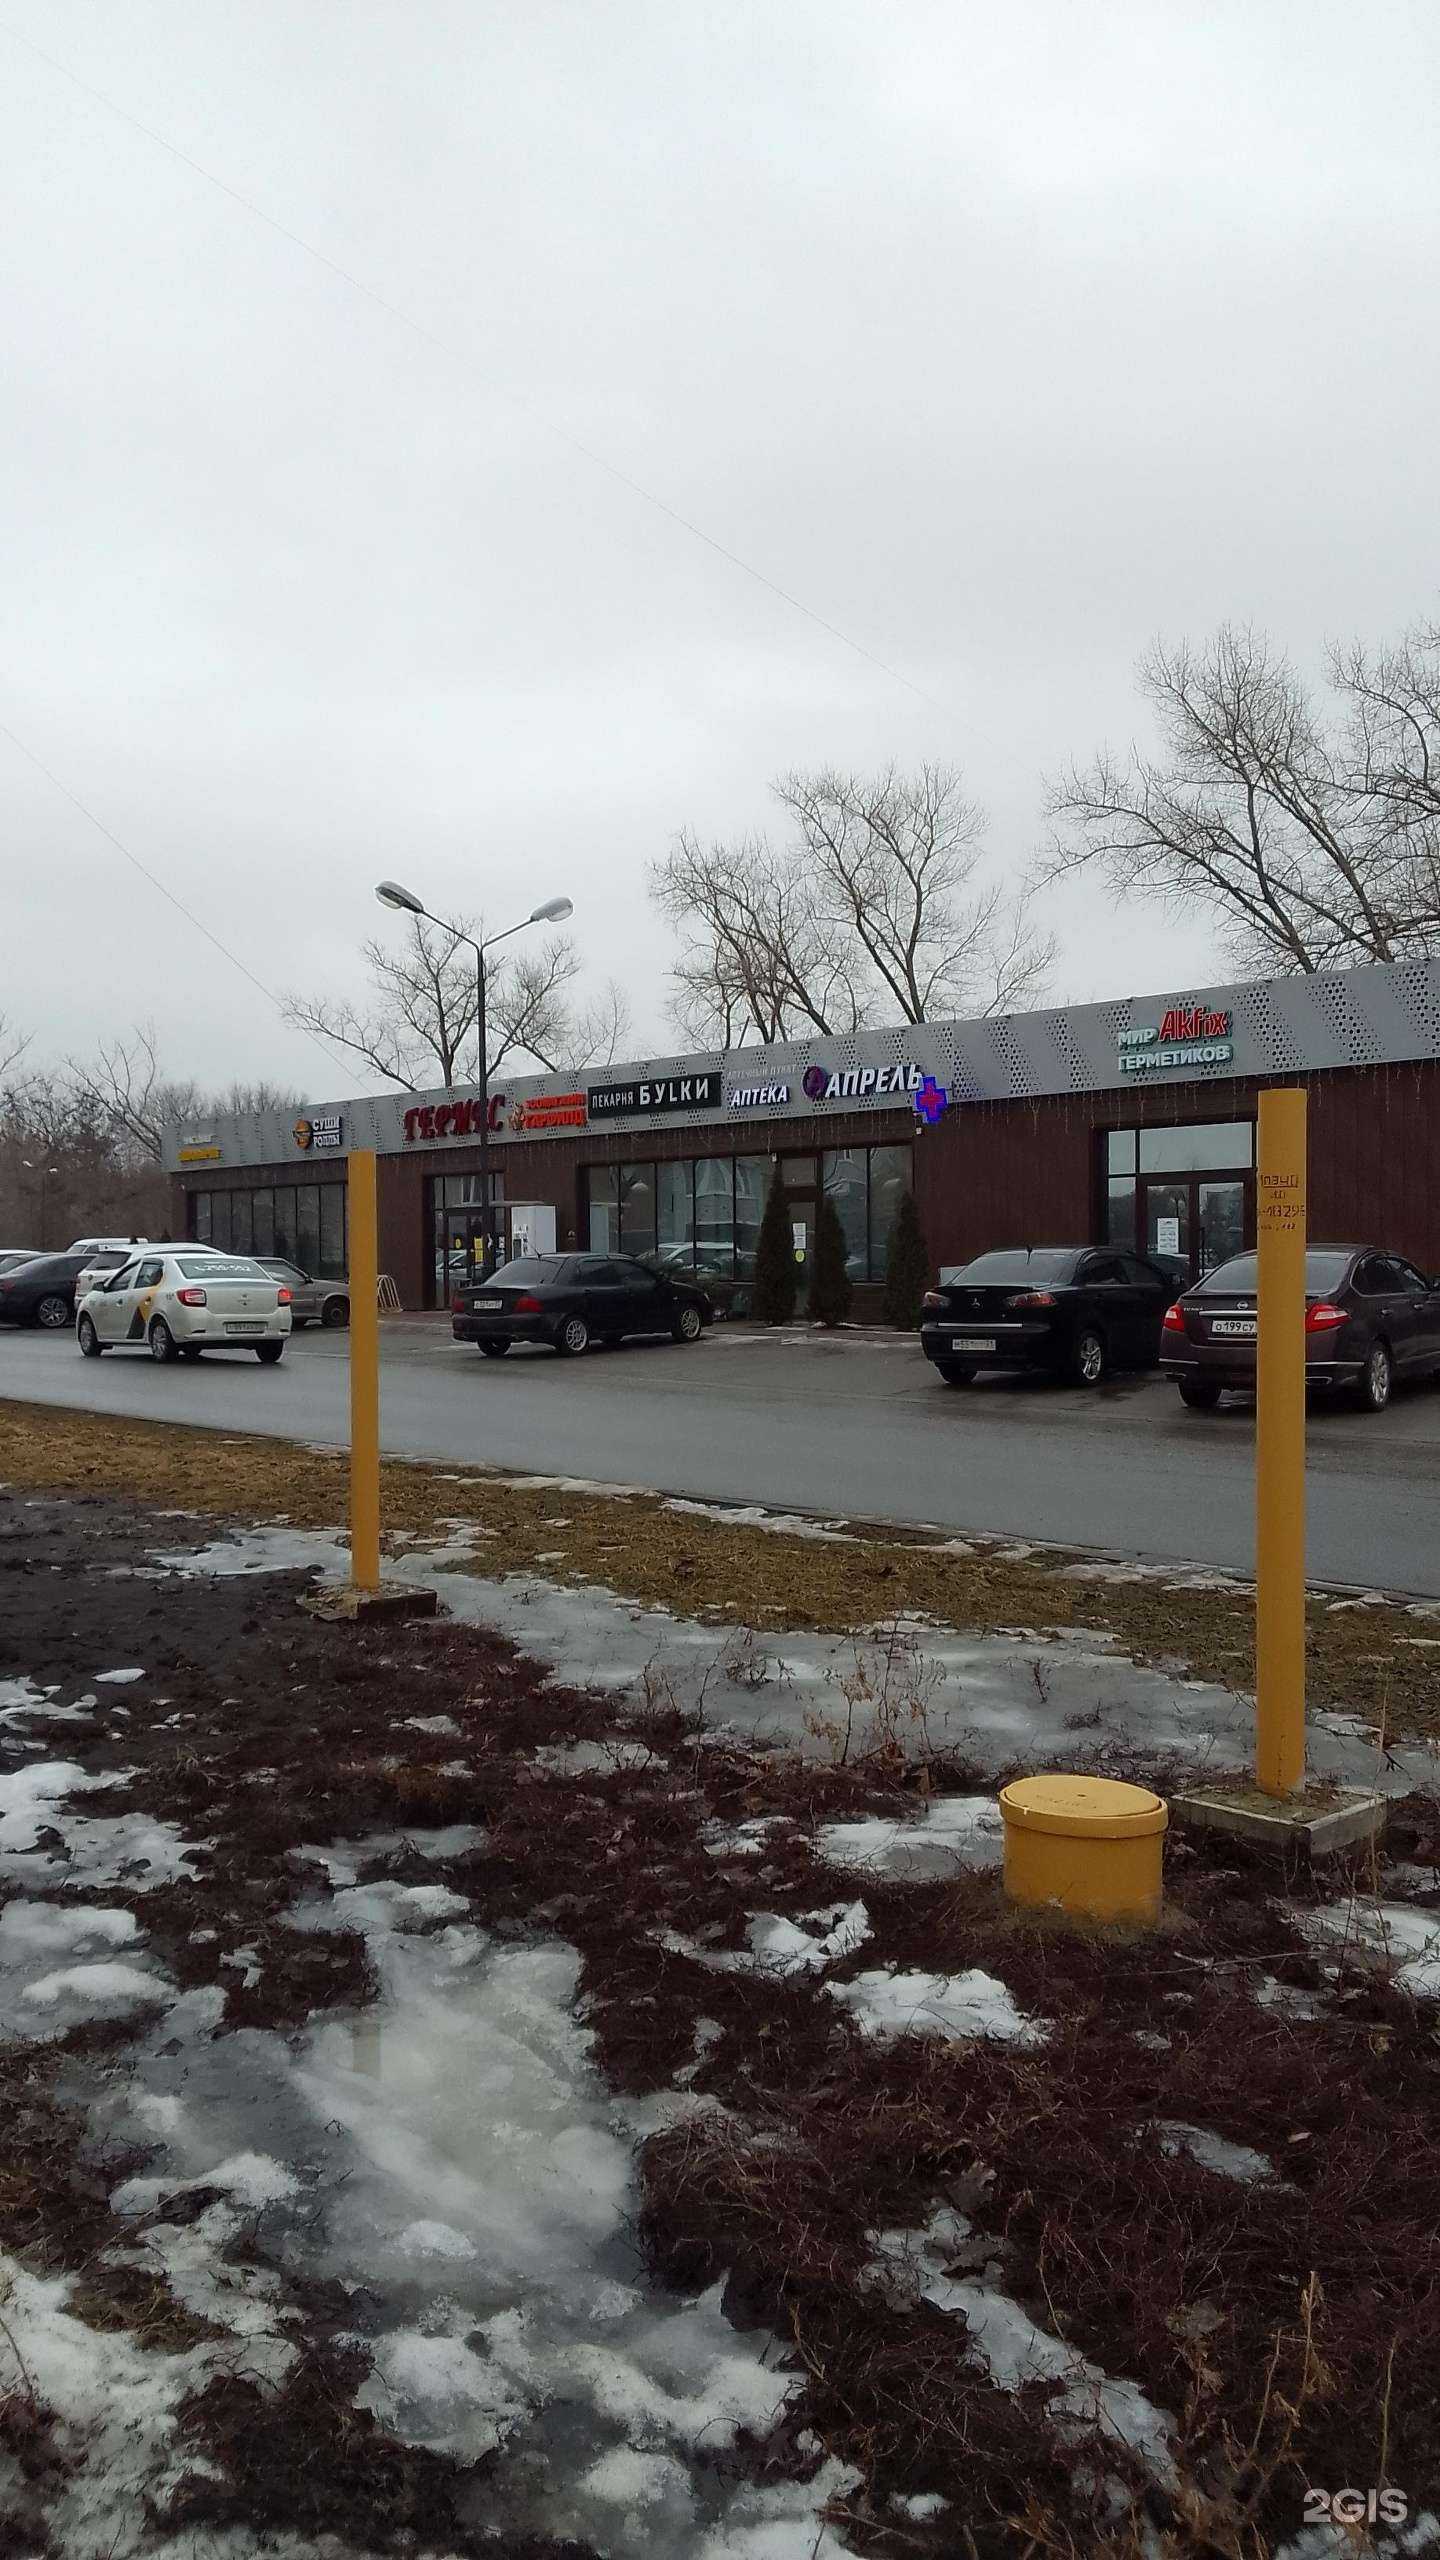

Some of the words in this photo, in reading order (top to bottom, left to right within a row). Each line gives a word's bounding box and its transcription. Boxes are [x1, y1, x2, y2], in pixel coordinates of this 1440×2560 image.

[1118, 1028, 1158, 1046] МИР
[1158, 1006, 1229, 1042] Akfix
[1118, 1045, 1232, 1071] ГЕРМЕТИКОВ
[824, 1064, 923, 1098] АПРЕЛЬ
[592, 1091, 634, 1109] ПЕКАРНЯ
[730, 1085, 789, 1107] АПТЕКА
[312, 1116, 341, 1132] СУШИ
[313, 1133, 341, 1148] РОЛЛЫ
